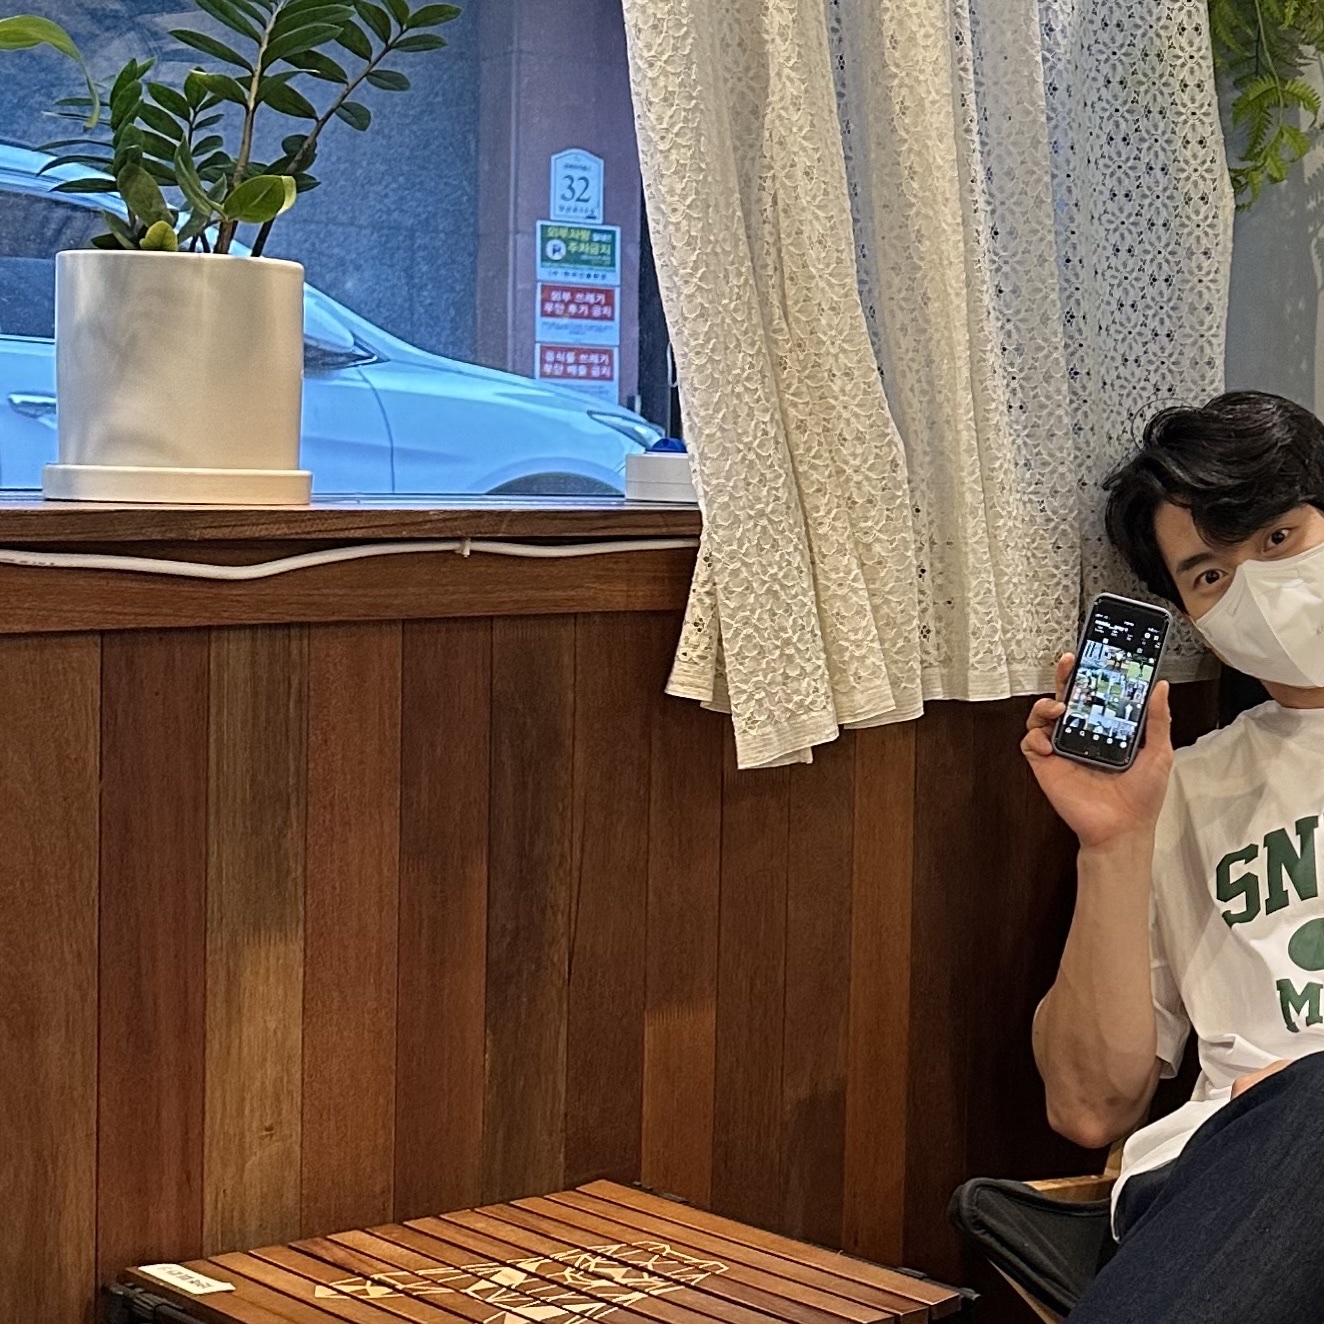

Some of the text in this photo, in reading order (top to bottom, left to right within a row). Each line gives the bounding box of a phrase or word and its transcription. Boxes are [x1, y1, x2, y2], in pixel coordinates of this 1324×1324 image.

[560, 174, 591, 203] 32
[567, 240, 612, 256] 주차금지
[550, 290, 606, 305] 외부 쓰레기
[543, 301, 566, 315] 무단
[591, 304, 612, 318] 금지
[578, 352, 610, 366] 쓰레기
[591, 364, 612, 378] 금지
